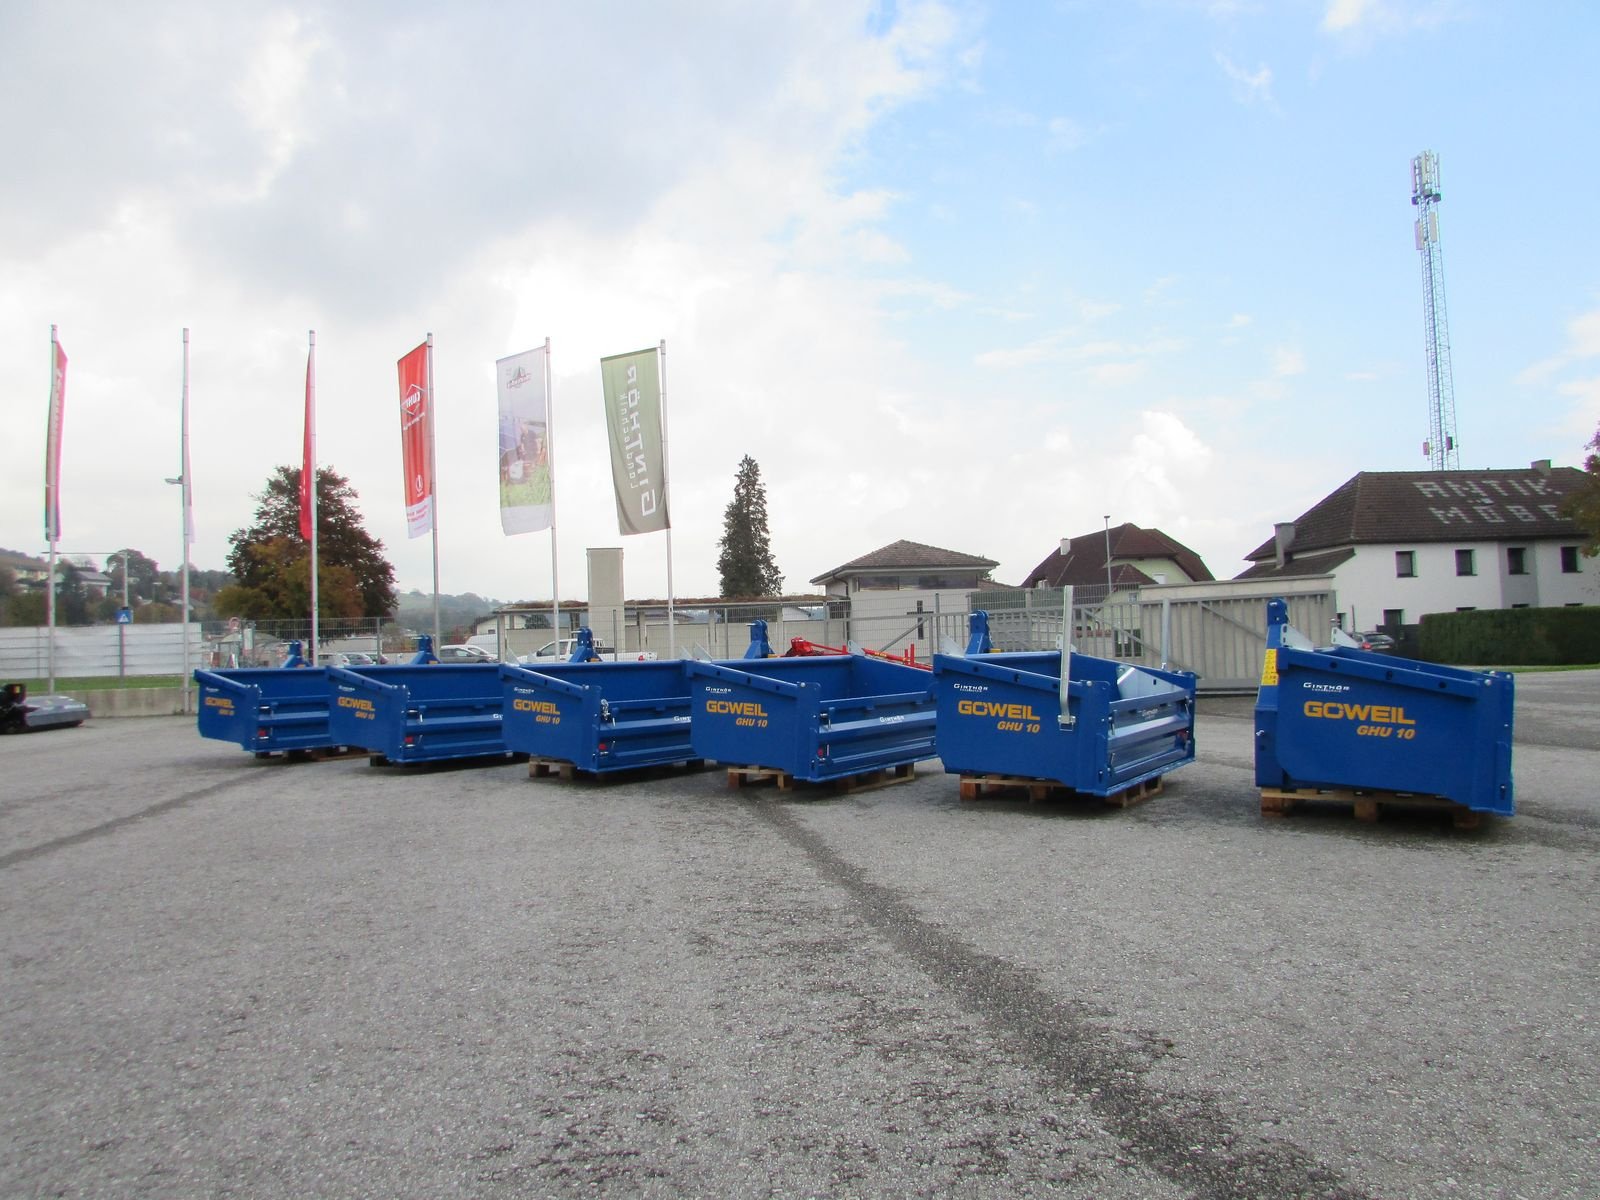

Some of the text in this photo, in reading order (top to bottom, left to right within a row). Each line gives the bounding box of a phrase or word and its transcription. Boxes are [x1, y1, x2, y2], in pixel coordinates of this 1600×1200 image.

[1429, 499, 1573, 524] MÖBE
[552, 716, 561, 725] 10
[735, 717, 768, 728] GHU 10
[997, 721, 1041, 733] GHU 10
[1356, 725, 1416, 740] GHU 10
